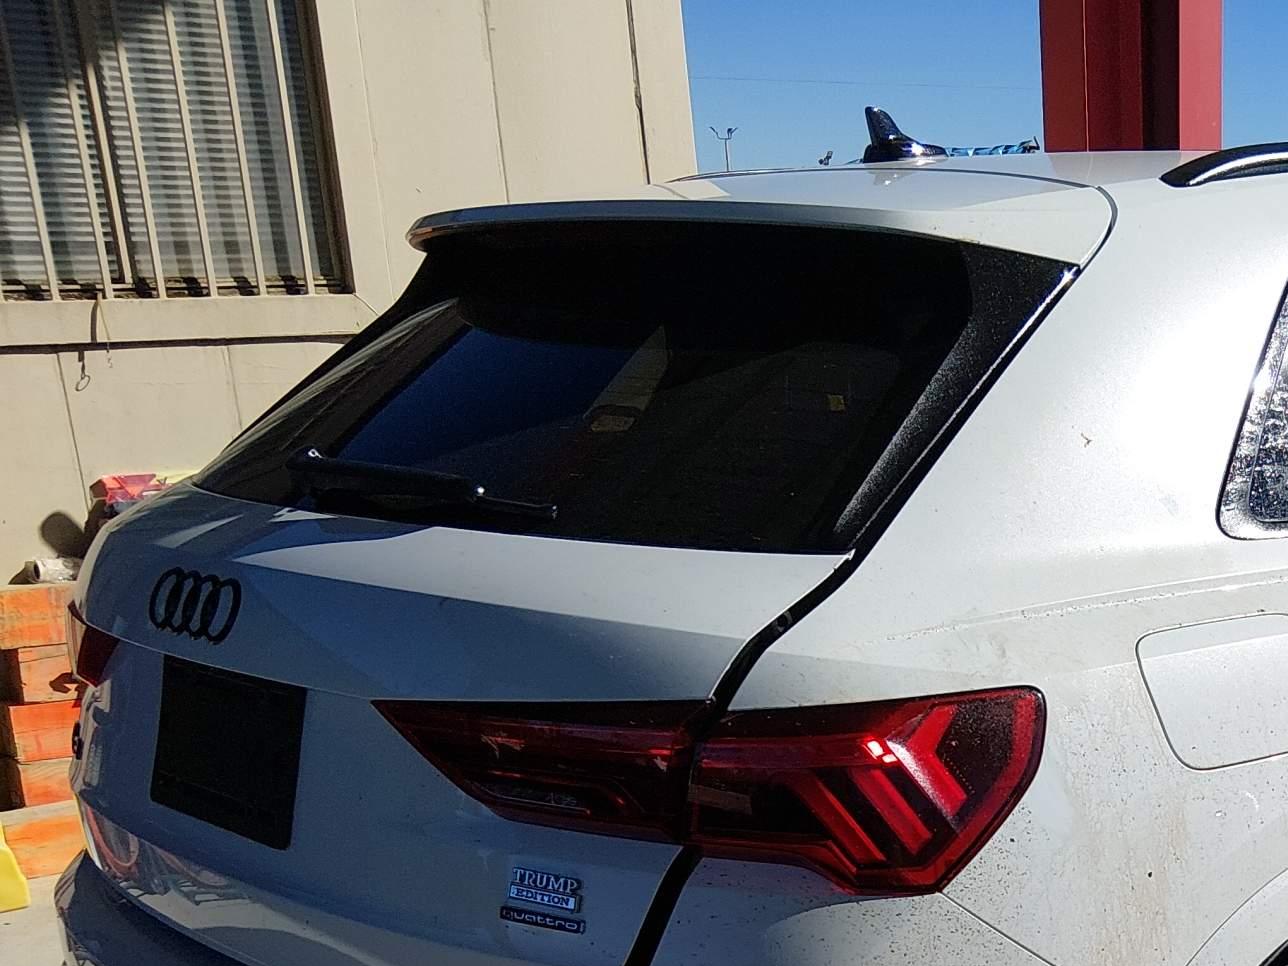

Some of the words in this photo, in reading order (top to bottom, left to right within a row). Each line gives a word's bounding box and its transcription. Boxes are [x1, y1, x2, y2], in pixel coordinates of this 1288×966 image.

[513, 868, 577, 894] TRUMP
[515, 888, 570, 907] EDITION
[502, 909, 578, 930] quattro
